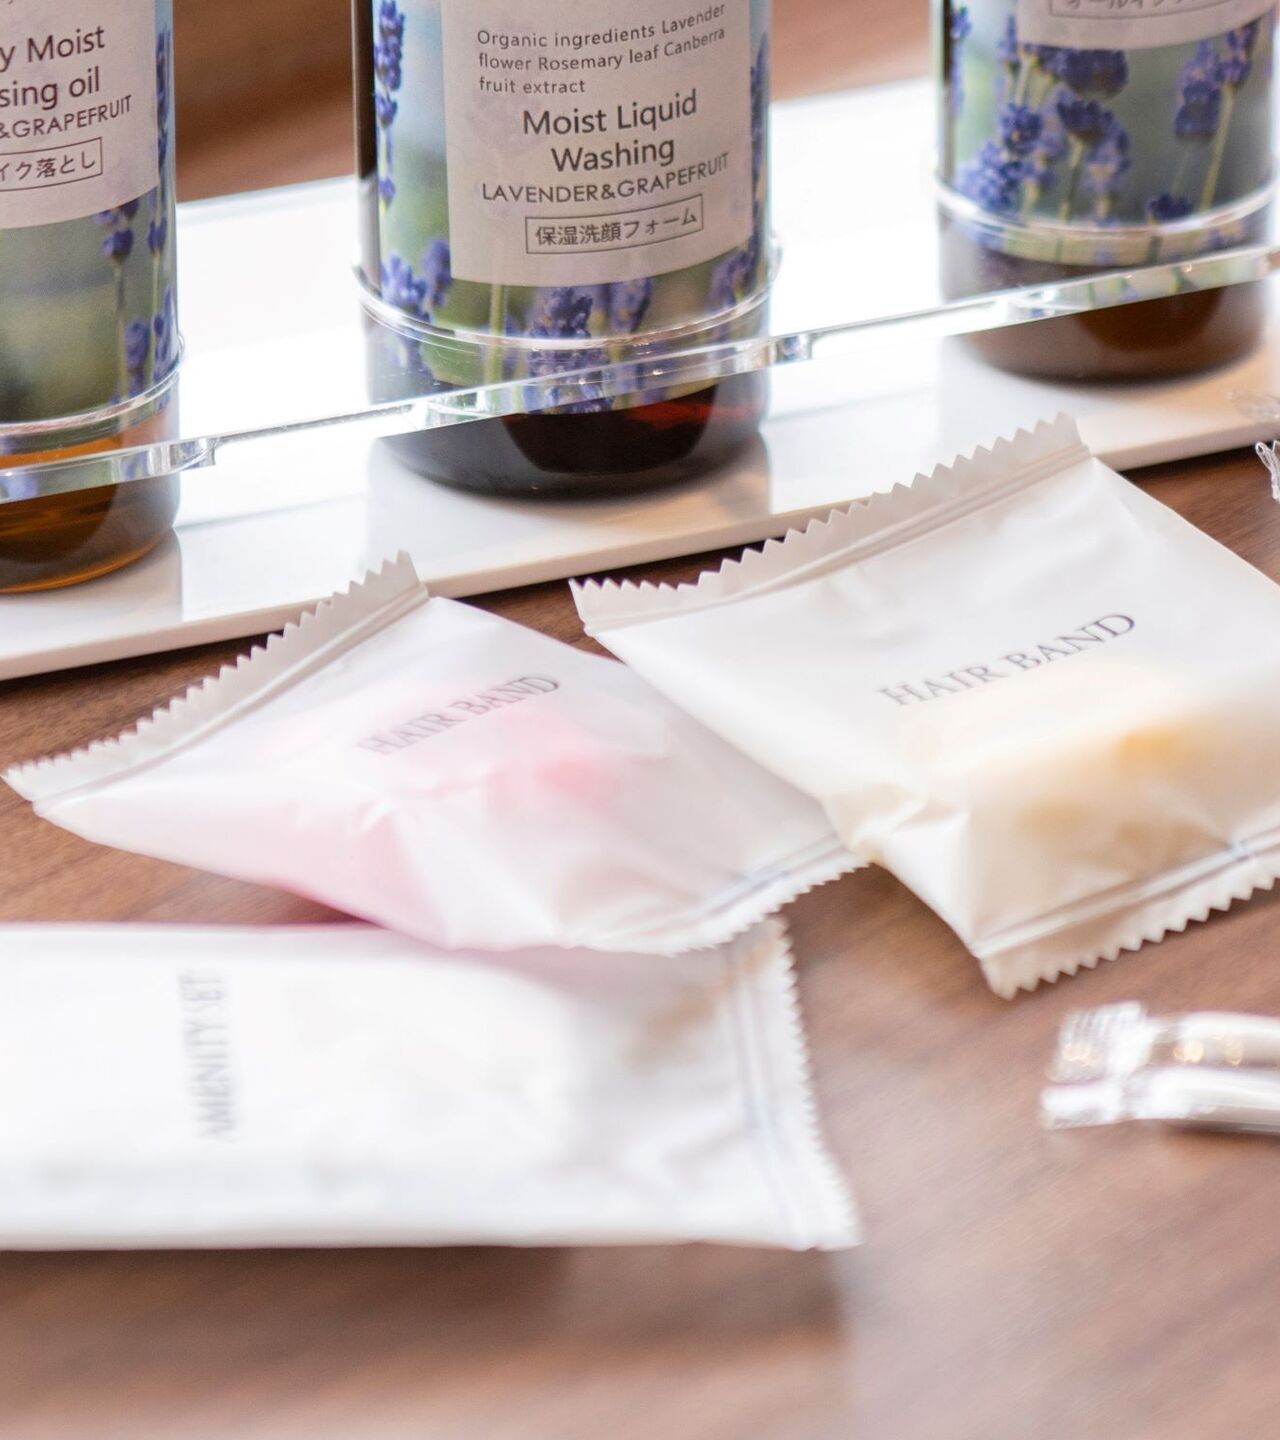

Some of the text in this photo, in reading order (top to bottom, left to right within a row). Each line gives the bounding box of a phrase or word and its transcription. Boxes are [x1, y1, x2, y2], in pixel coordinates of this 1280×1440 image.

[27, 25, 105, 62] Moist
[477, 3, 725, 50] Organic ingredients Lavender
[478, 28, 725, 71] flower Rosemary leaf Canberra
[68, 66, 101, 98] oil
[479, 76, 586, 95] fruit extract
[522, 88, 697, 136] Moist Liquid
[550, 138, 674, 173] Washing
[481, 152, 729, 203] LAVENDER&GRAPEFRUIT
[535, 208, 697, 246] 保湿洗顔フォーム
[878, 613, 1135, 707] HAIR BAND
[356, 676, 560, 756] HAIR BAND
